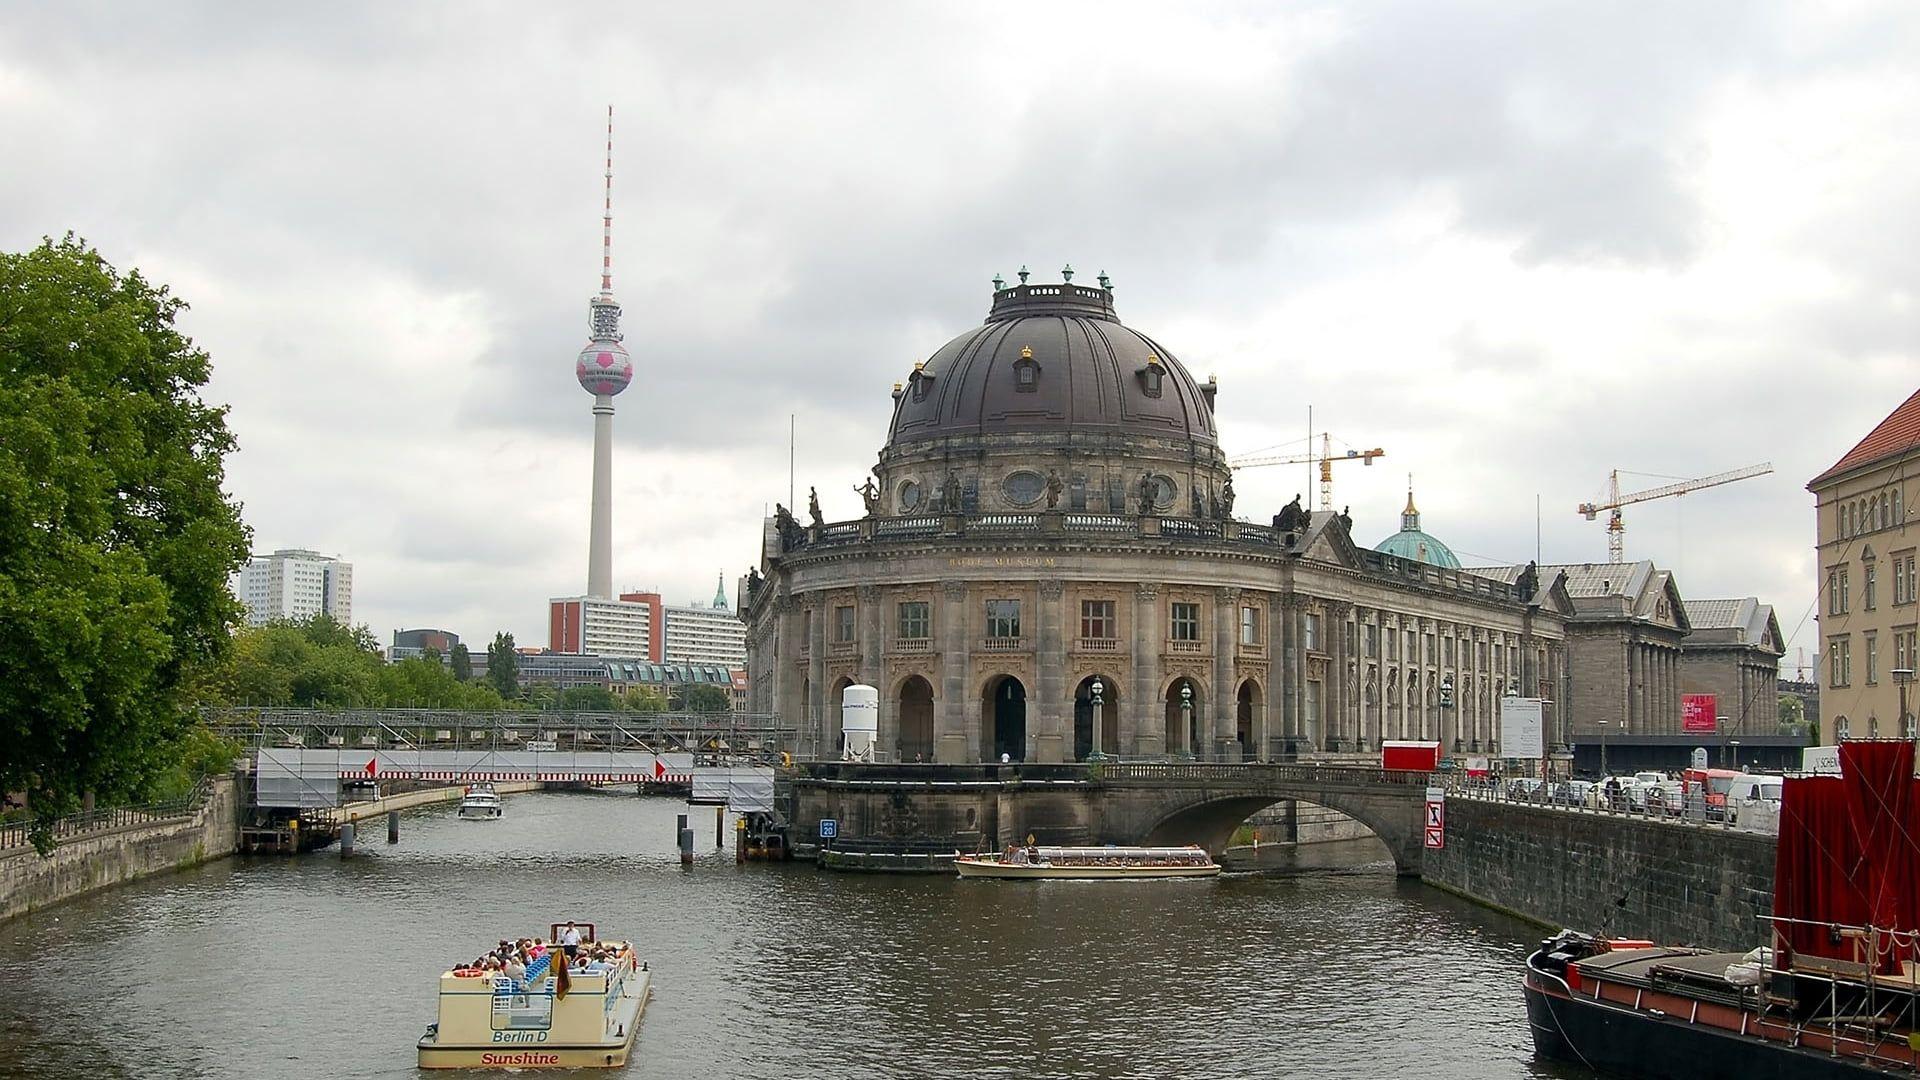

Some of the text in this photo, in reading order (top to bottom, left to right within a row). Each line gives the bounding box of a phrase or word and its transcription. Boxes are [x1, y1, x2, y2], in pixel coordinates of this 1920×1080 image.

[823, 827, 833, 835] 20
[493, 1031, 548, 1042] Berlin D
[482, 1052, 559, 1065] Sunshine
